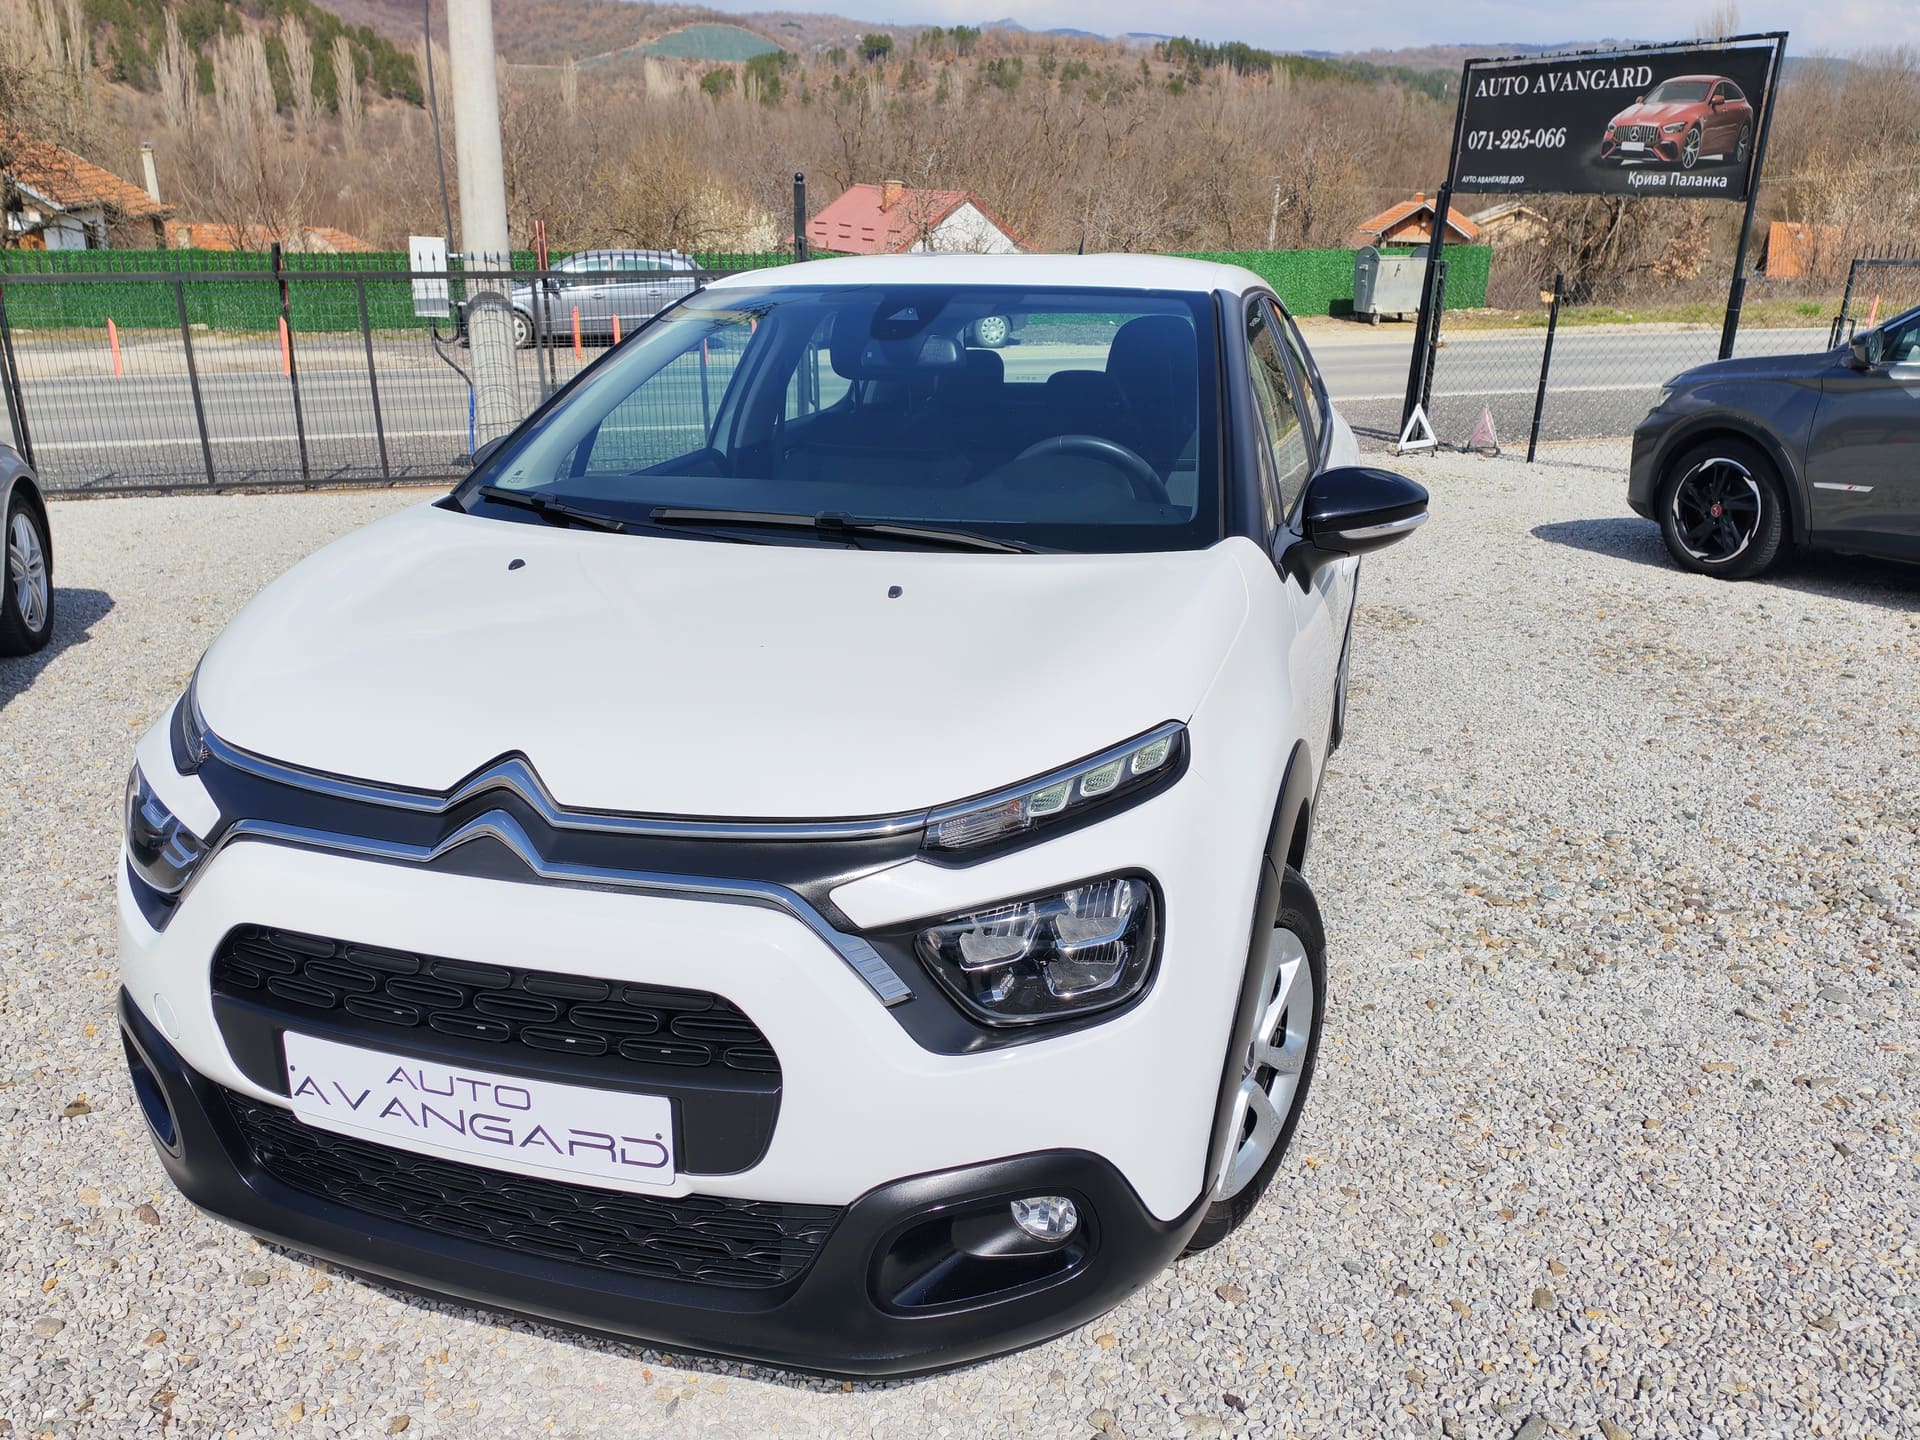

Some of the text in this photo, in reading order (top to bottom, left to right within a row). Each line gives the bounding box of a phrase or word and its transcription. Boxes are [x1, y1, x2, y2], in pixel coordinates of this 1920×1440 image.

[1475, 66, 1652, 97] AUTO AVANGARD
[1468, 127, 1567, 150] 071-225-066
[1461, 175, 1477, 184] АУТО
[1509, 175, 1525, 185] ДОО
[1628, 171, 1728, 188] Крива Паланка
[386, 1066, 531, 1111] AUTO
[294, 1075, 669, 1168] AVANGARD
